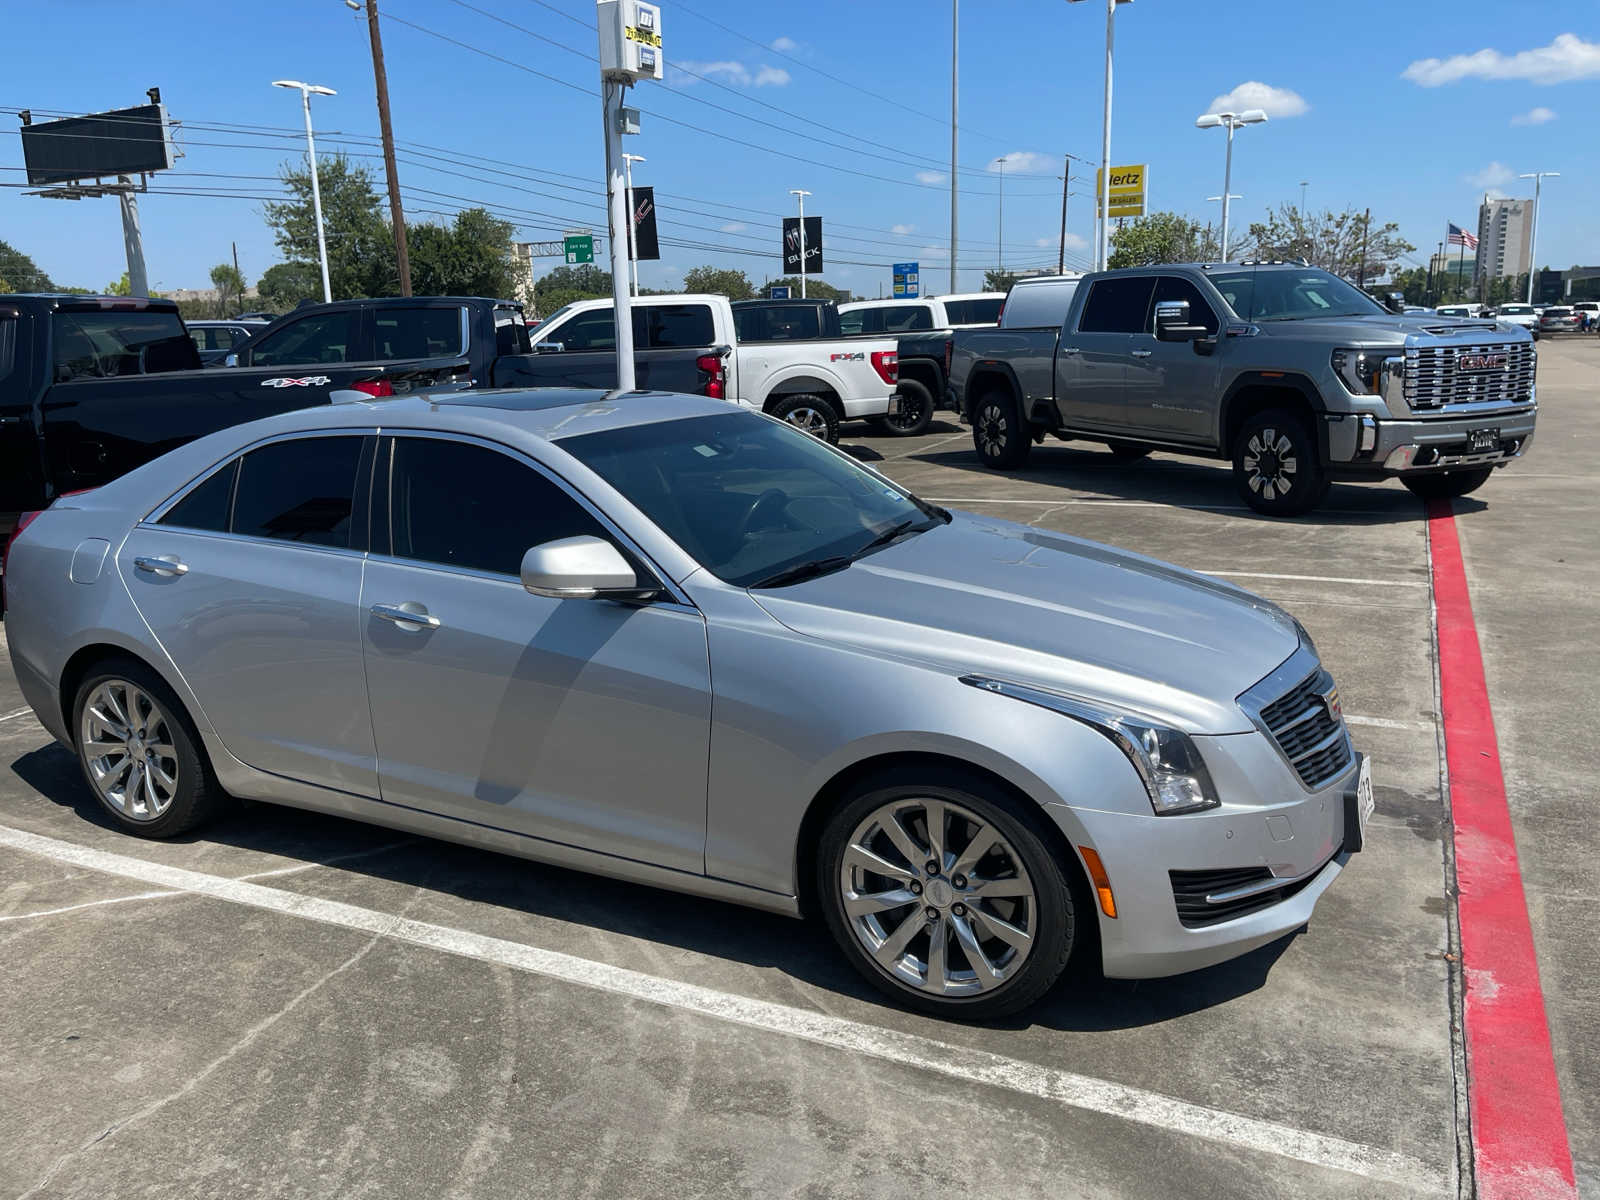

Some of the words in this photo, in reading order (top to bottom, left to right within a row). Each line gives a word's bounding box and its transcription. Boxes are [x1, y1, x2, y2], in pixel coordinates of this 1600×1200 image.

[788, 247, 820, 264] BUCK
[830, 352, 865, 362] FX4
[1460, 354, 1508, 369] GMC
